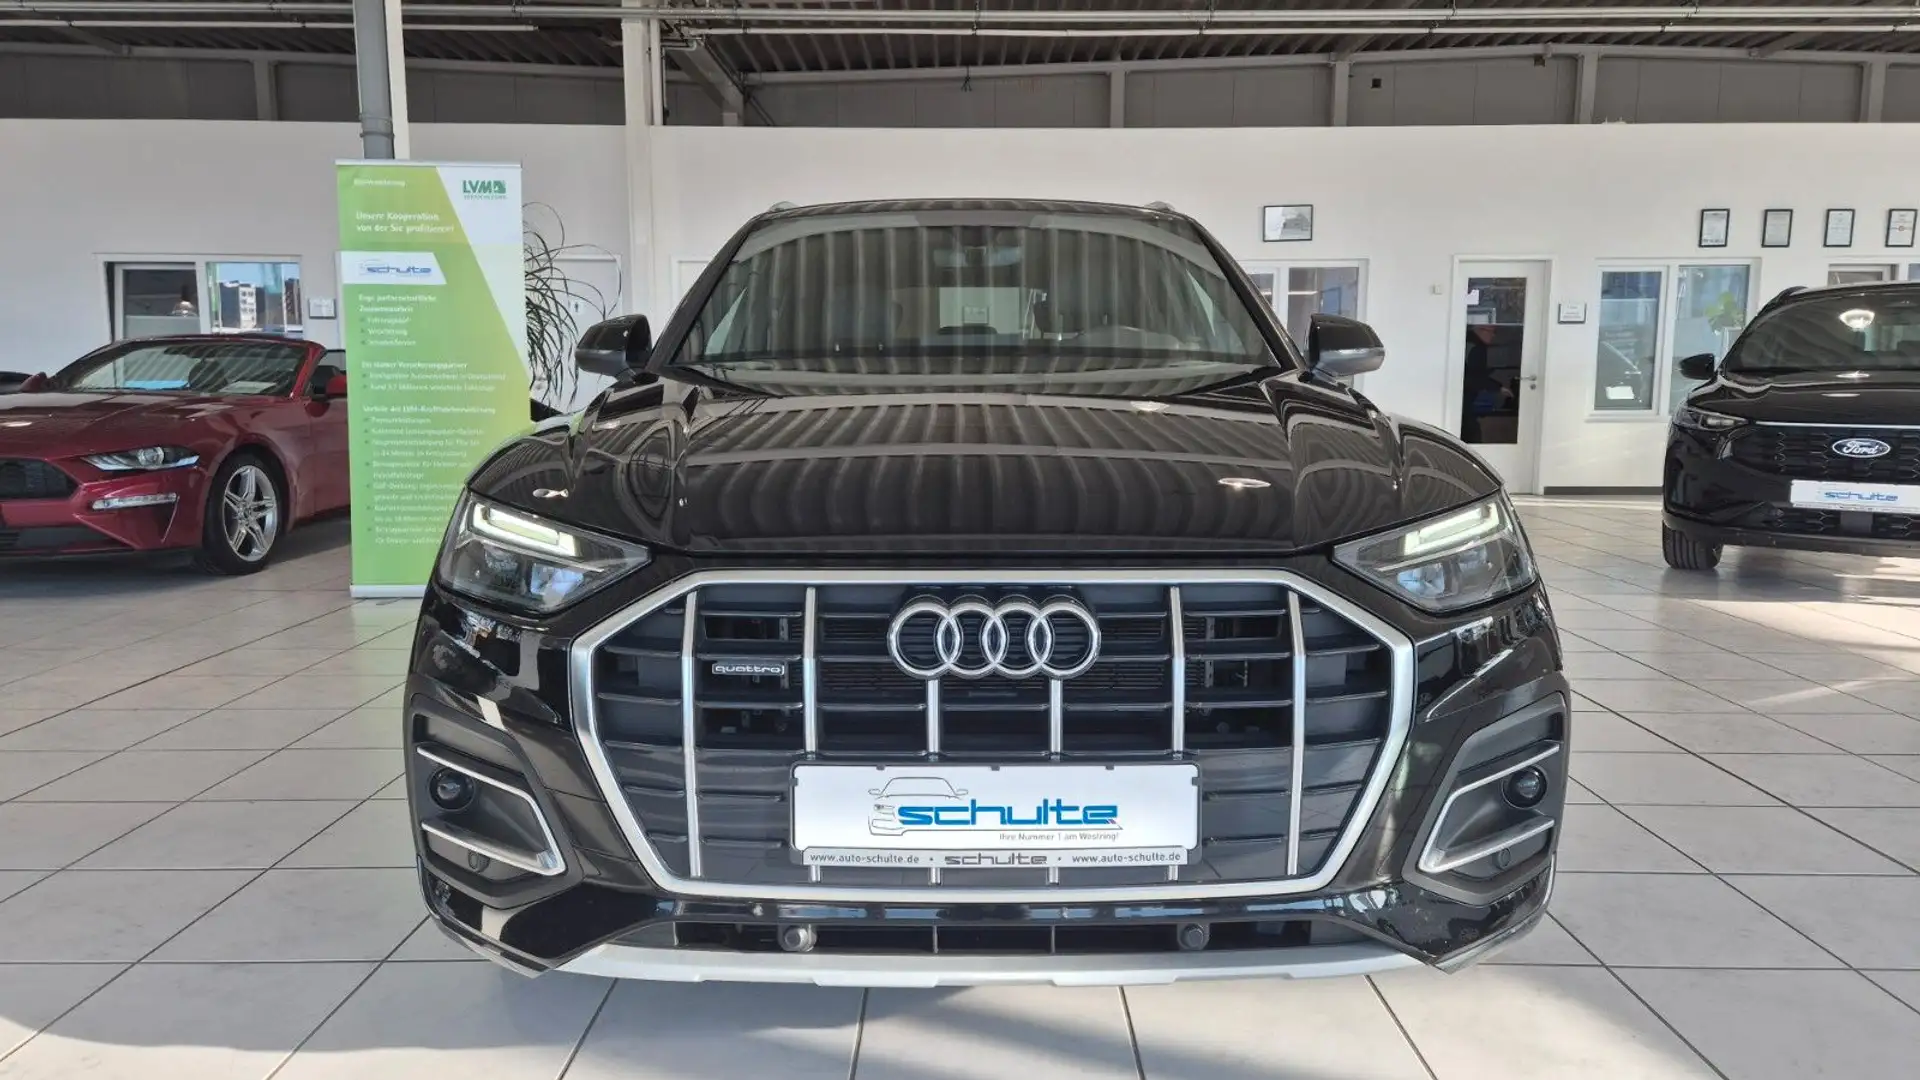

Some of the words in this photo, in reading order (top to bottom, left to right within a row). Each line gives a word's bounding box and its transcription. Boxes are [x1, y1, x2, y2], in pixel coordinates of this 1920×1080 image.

[462, 180, 492, 193] LVM
[356, 212, 384, 220] Unsere
[387, 211, 439, 222] Kooperation
[1842, 440, 1879, 454] Ford
[1824, 491, 1898, 502] schulte
[715, 665, 781, 673] quattro
[898, 799, 1117, 825] schulte
[999, 833, 1016, 841] Ihre
[1018, 833, 1055, 841] Nummer
[1079, 832, 1119, 841] Westring!
[810, 853, 920, 864] www.auto-schulte.de
[944, 853, 1047, 865] schulte
[1072, 851, 1181, 863] www.auto-schulte.de
